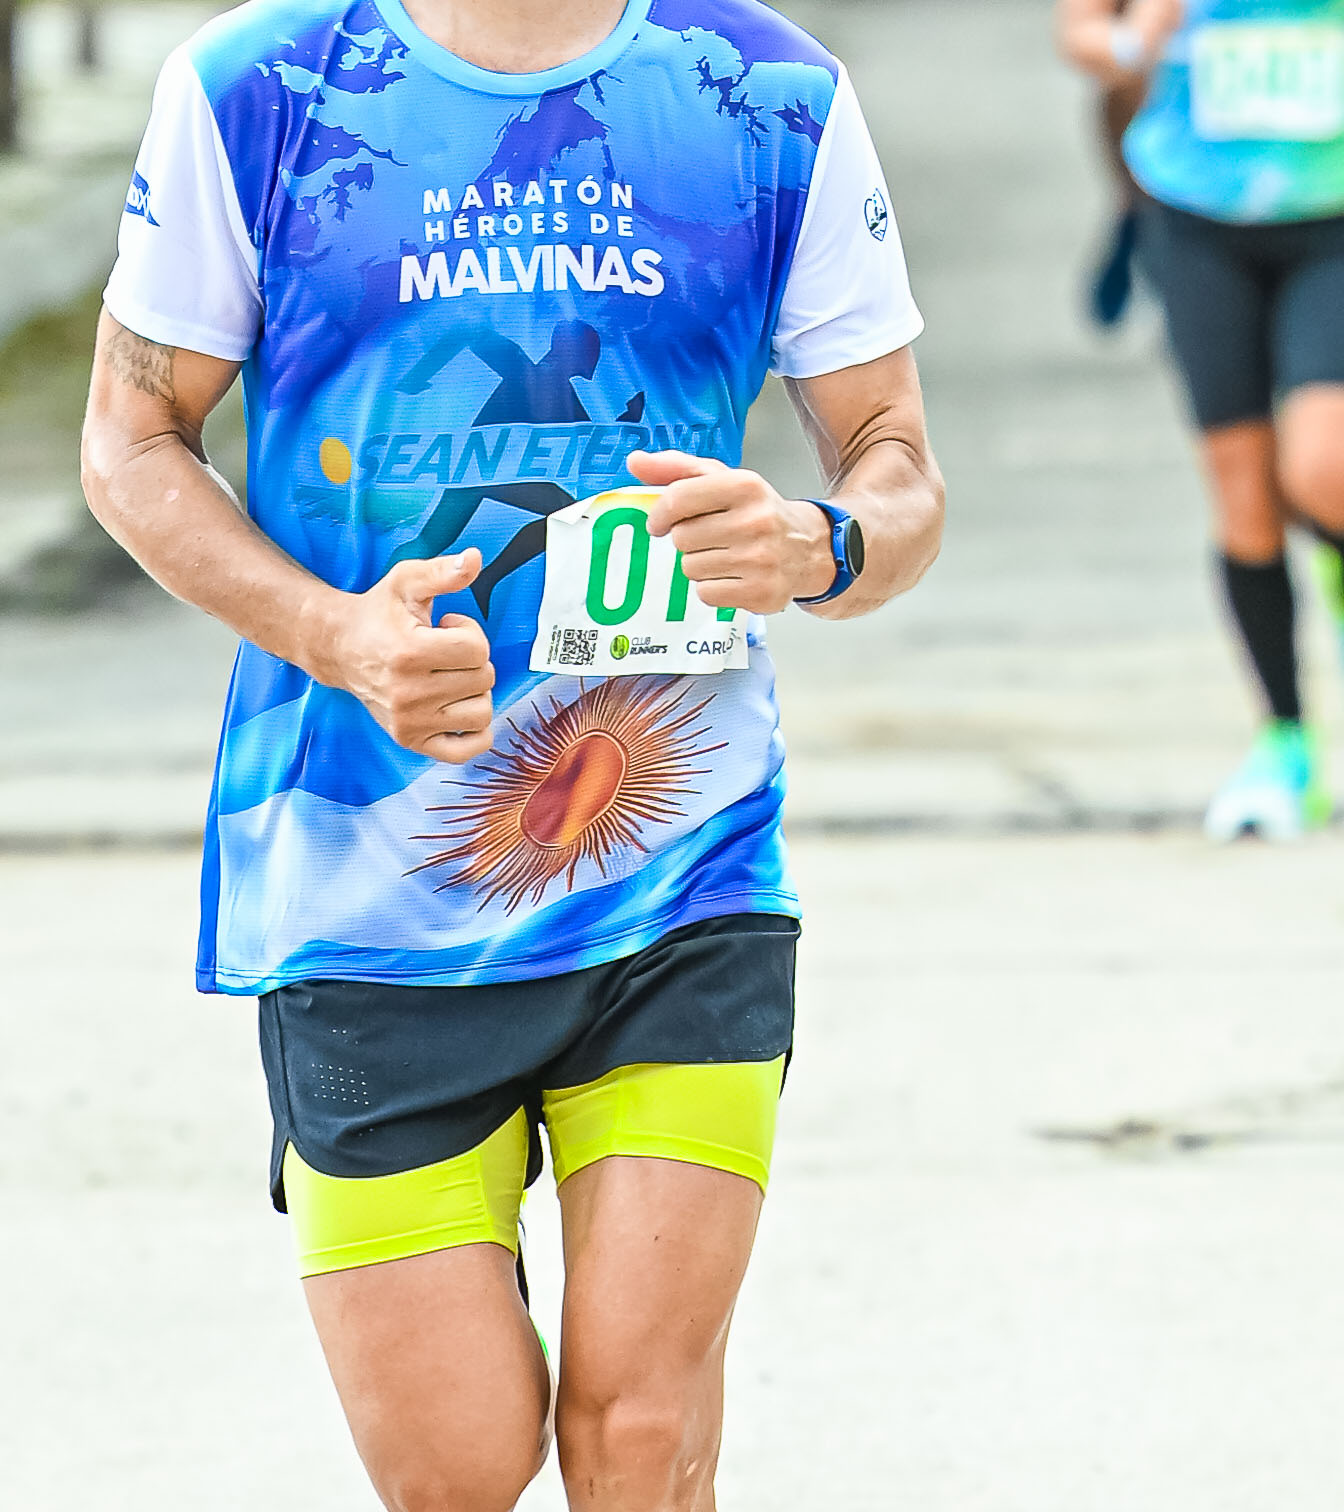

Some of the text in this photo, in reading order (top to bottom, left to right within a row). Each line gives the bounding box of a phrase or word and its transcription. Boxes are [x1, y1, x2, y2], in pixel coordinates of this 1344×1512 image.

[422, 175, 634, 215] MARATÓN
[424, 210, 635, 242] HÉROES DE
[398, 243, 666, 304] MALVINAS
[358, 427, 513, 487] SEAN
